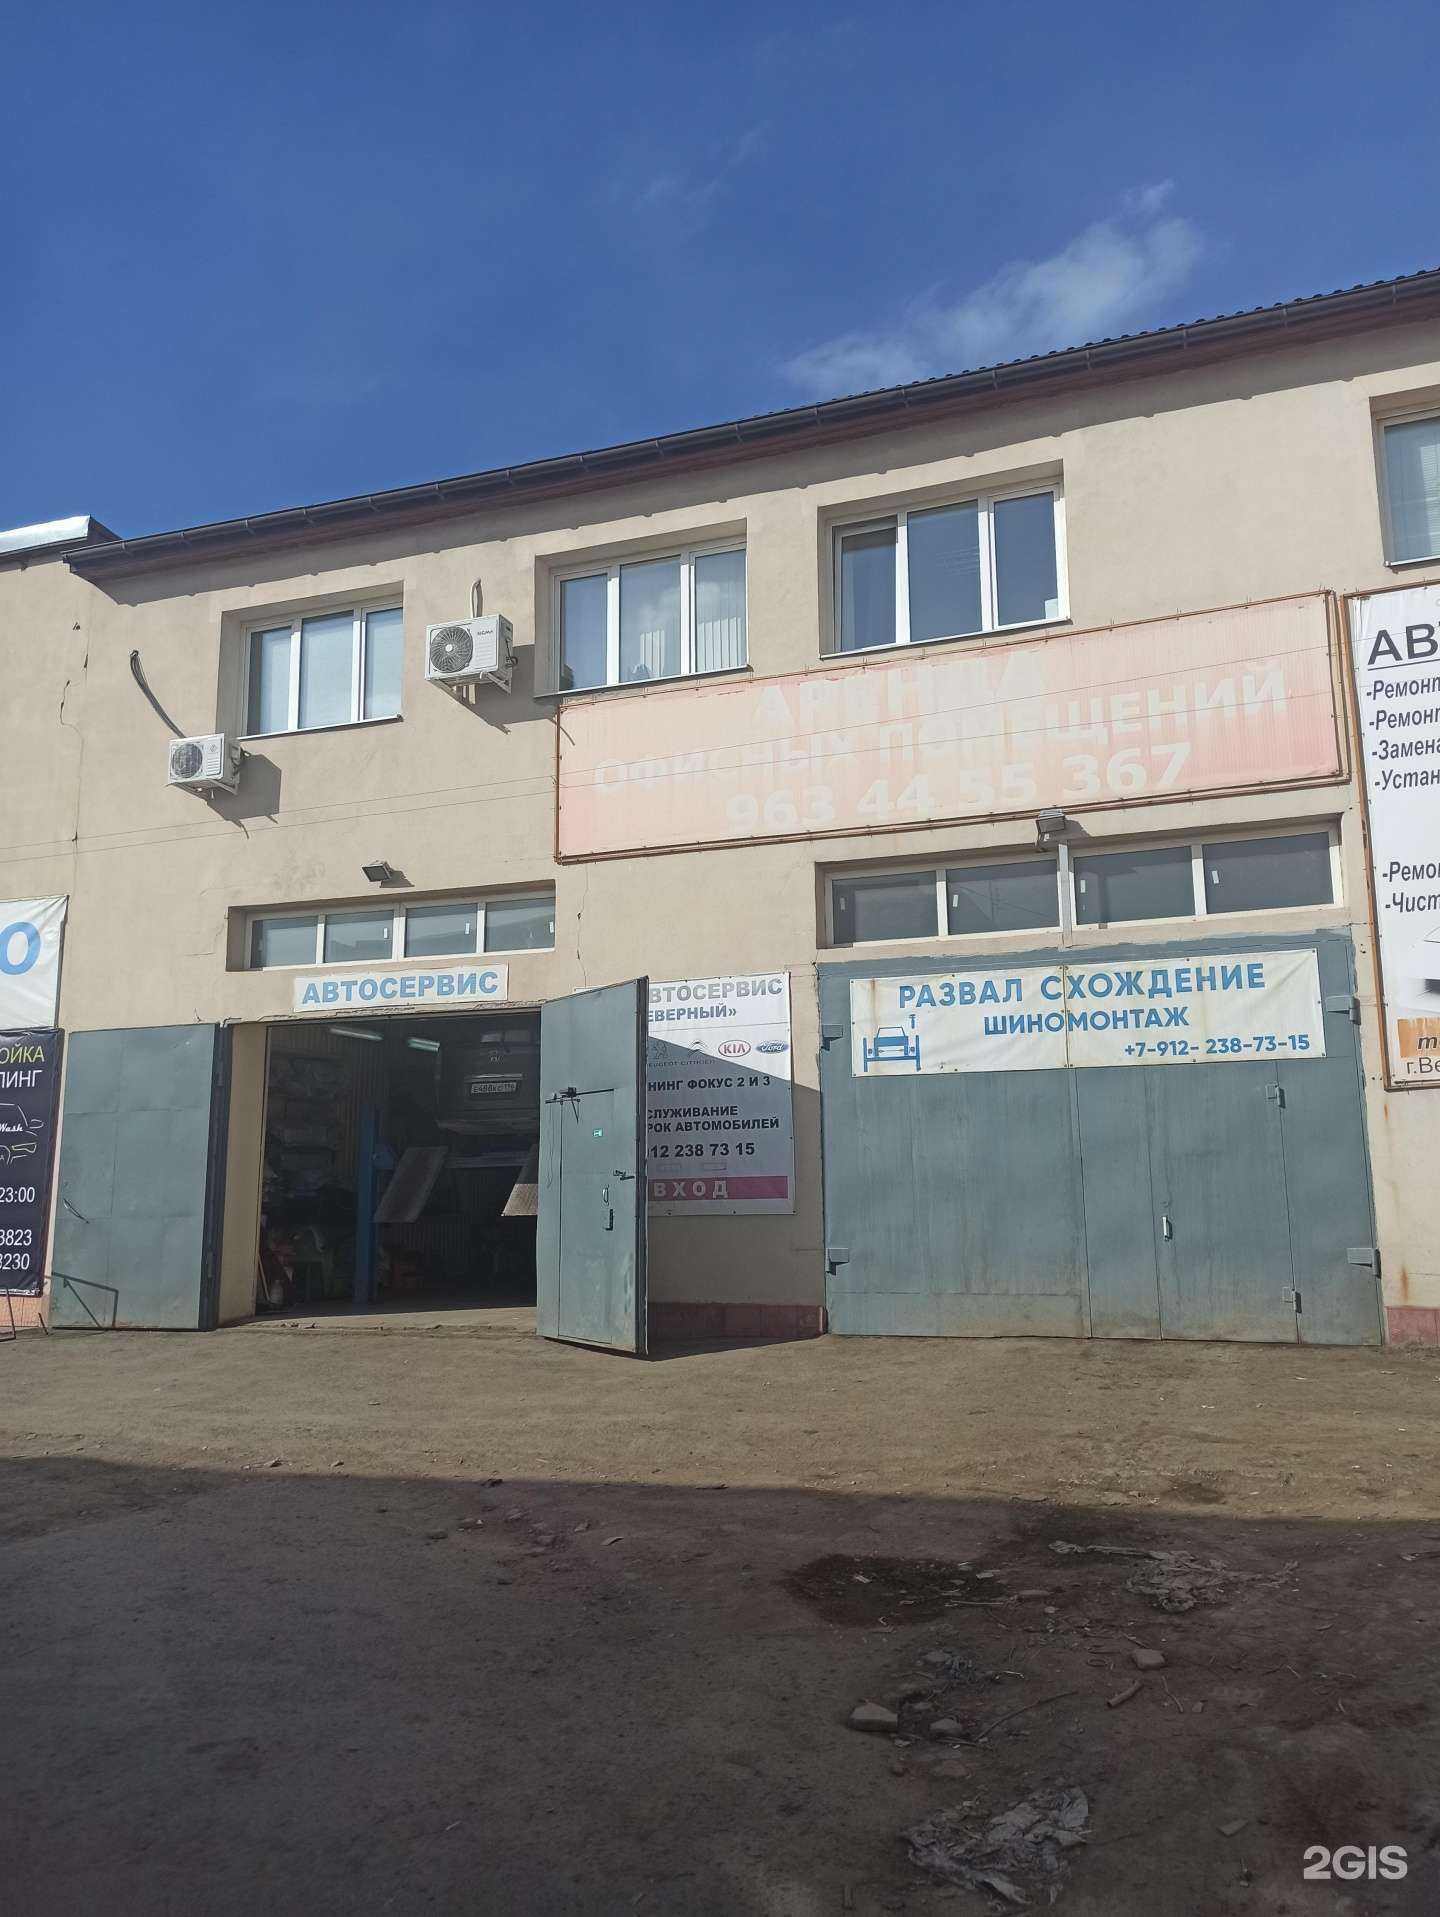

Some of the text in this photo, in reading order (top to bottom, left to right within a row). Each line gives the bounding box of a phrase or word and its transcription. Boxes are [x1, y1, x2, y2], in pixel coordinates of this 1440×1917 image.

[1368, 621, 1440, 665] АВ
[726, 743, 1191, 833] 963 44 55 367
[1382, 861, 1440, 883] -Ремо
[302, 971, 499, 1004] АВТОСЕРВИС
[899, 963, 1266, 1009] РАЗВАЛ СХОЖДЕНИЕ
[984, 1006, 1190, 1036] ШИНОМОНТАЖ
[724, 1044, 746, 1054] KIA
[1206, 1034, 1311, 1055] 238-73-15
[688, 1078, 733, 1089] ФОКУС
[737, 1077, 745, 1087] 2
[750, 1077, 759, 1086] И
[763, 1076, 770, 1086] 3
[676, 1116, 779, 1132] АВТОМОБИЛЕЙ
[648, 1142, 755, 1158] 12 238 73 15
